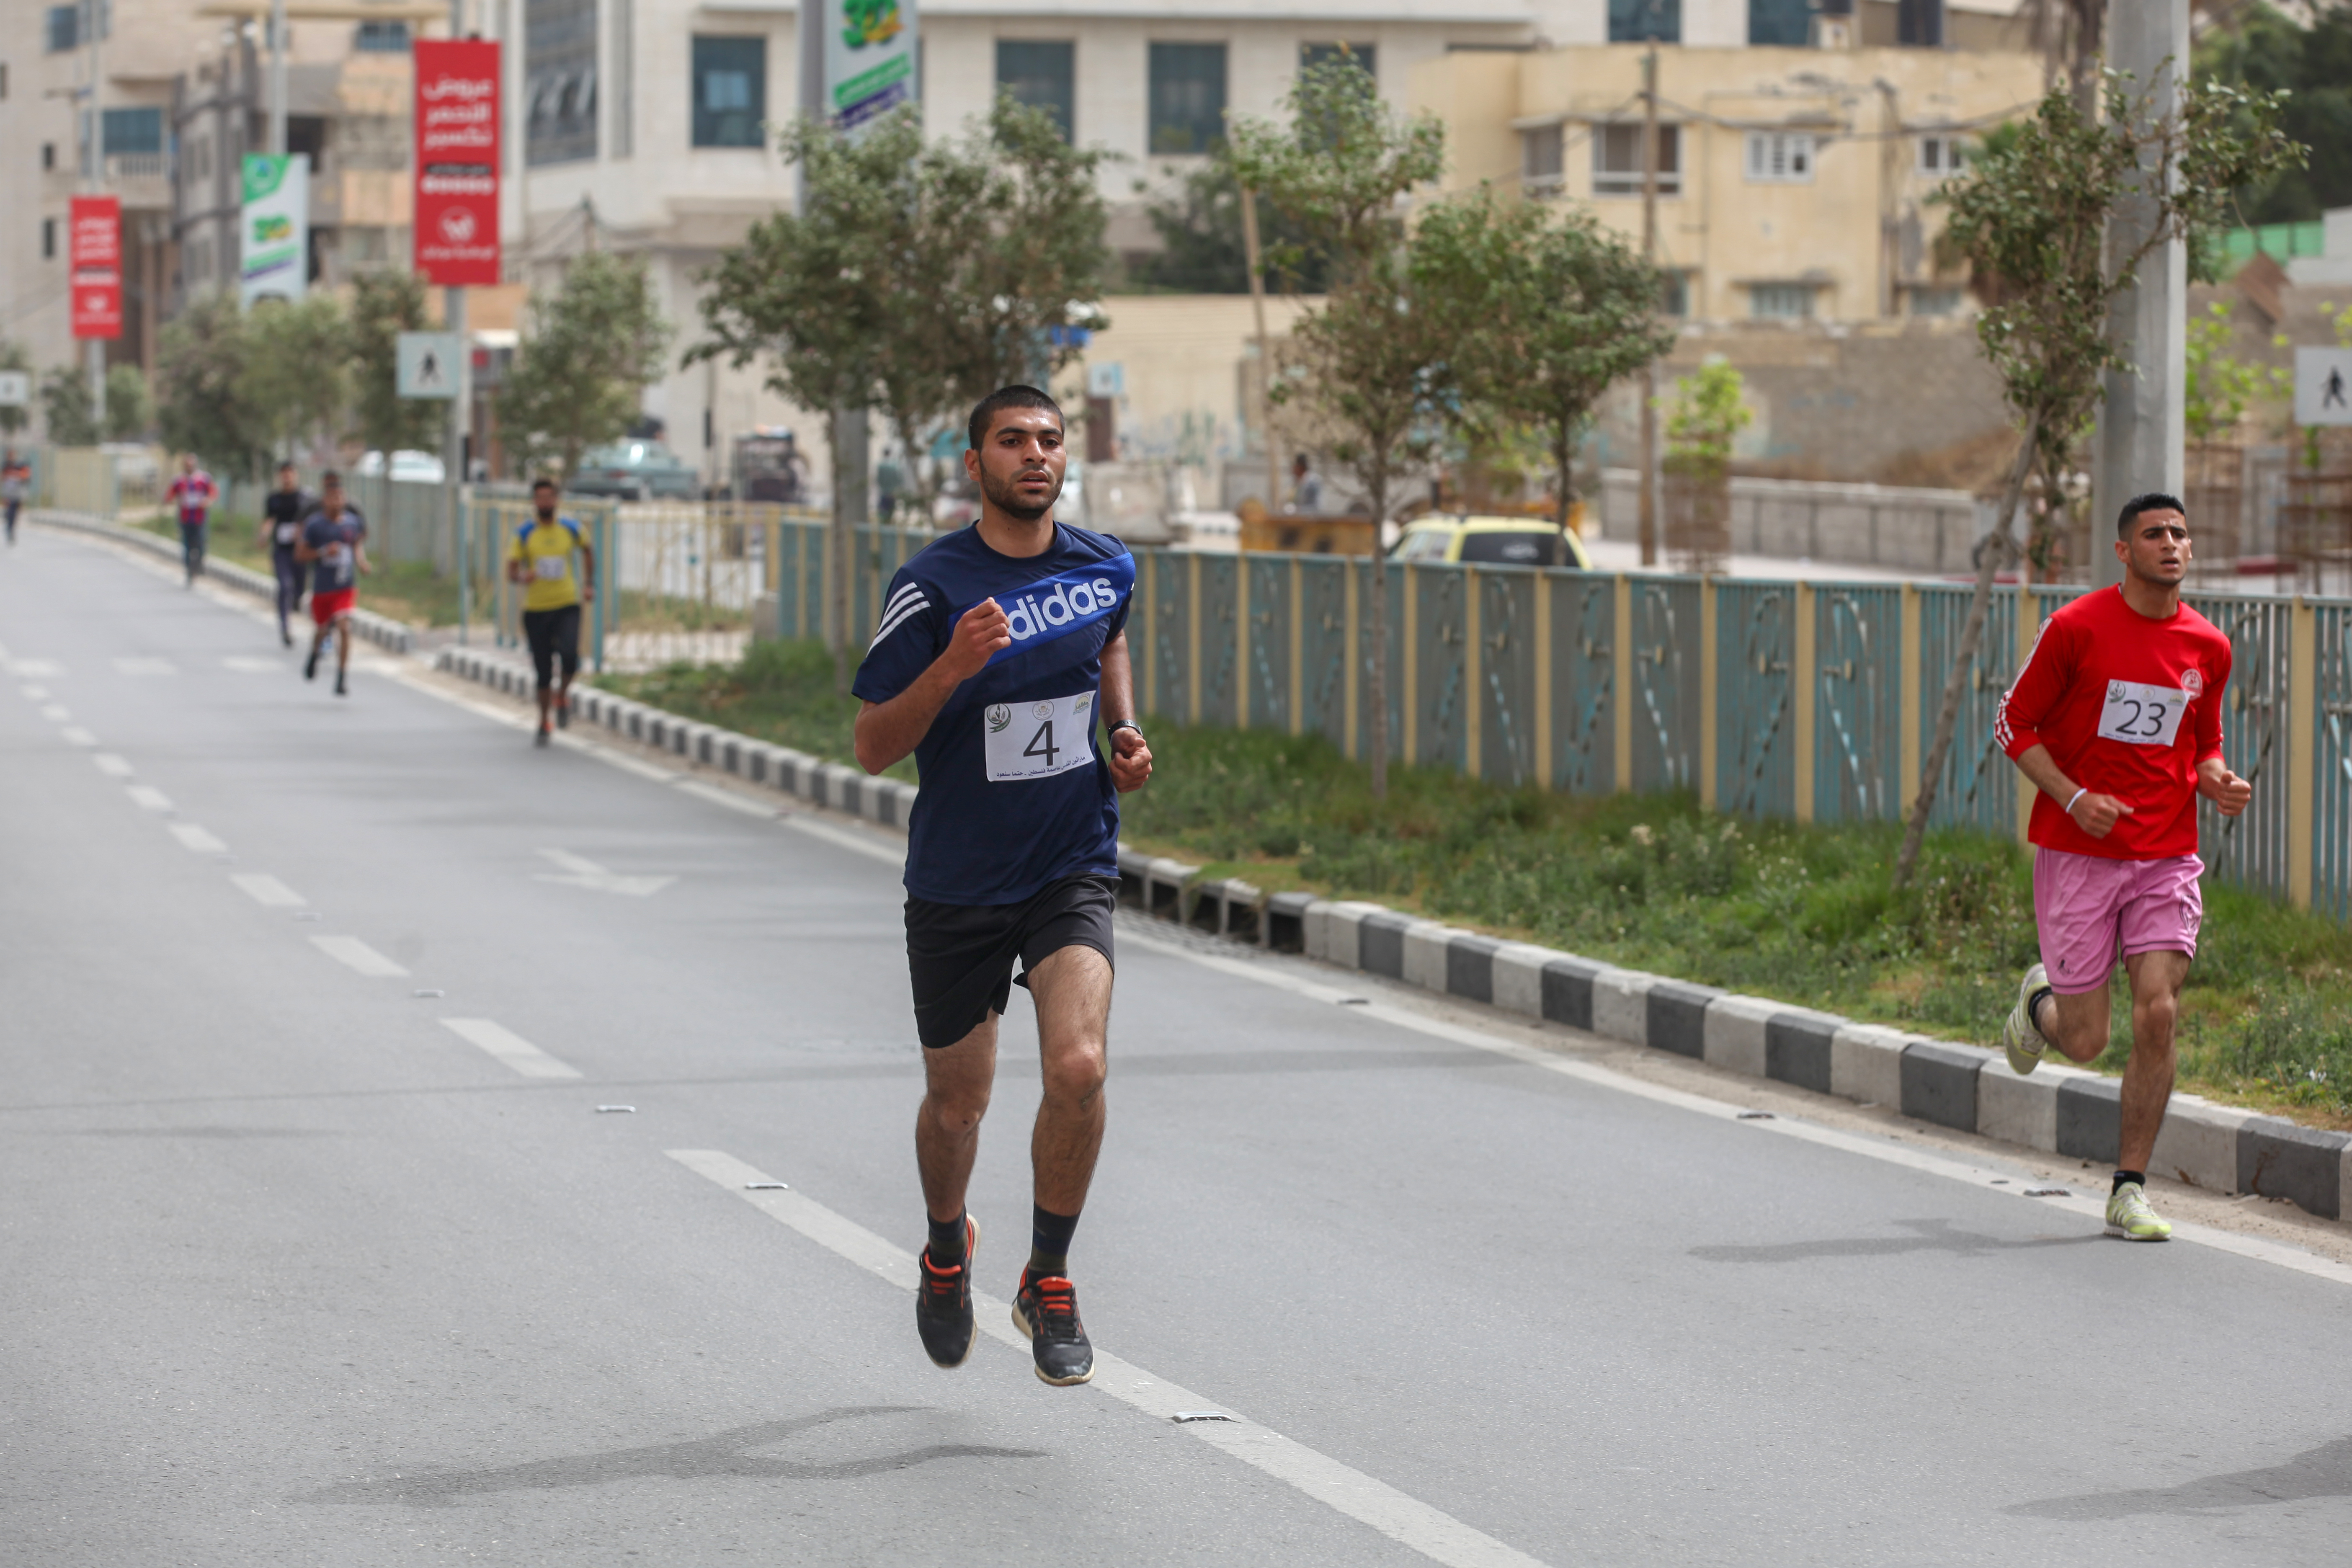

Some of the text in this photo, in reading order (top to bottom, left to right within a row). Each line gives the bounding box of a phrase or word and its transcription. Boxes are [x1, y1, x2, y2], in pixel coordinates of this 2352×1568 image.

[1008, 578, 1117, 640] didas
[2115, 699, 2166, 736] 23
[1023, 720, 1060, 766] 4
[1028, 768, 1046, 776] فلسطين
[1061, 760, 1071, 770] القدس
[1072, 756, 1086, 765] ماراثون
